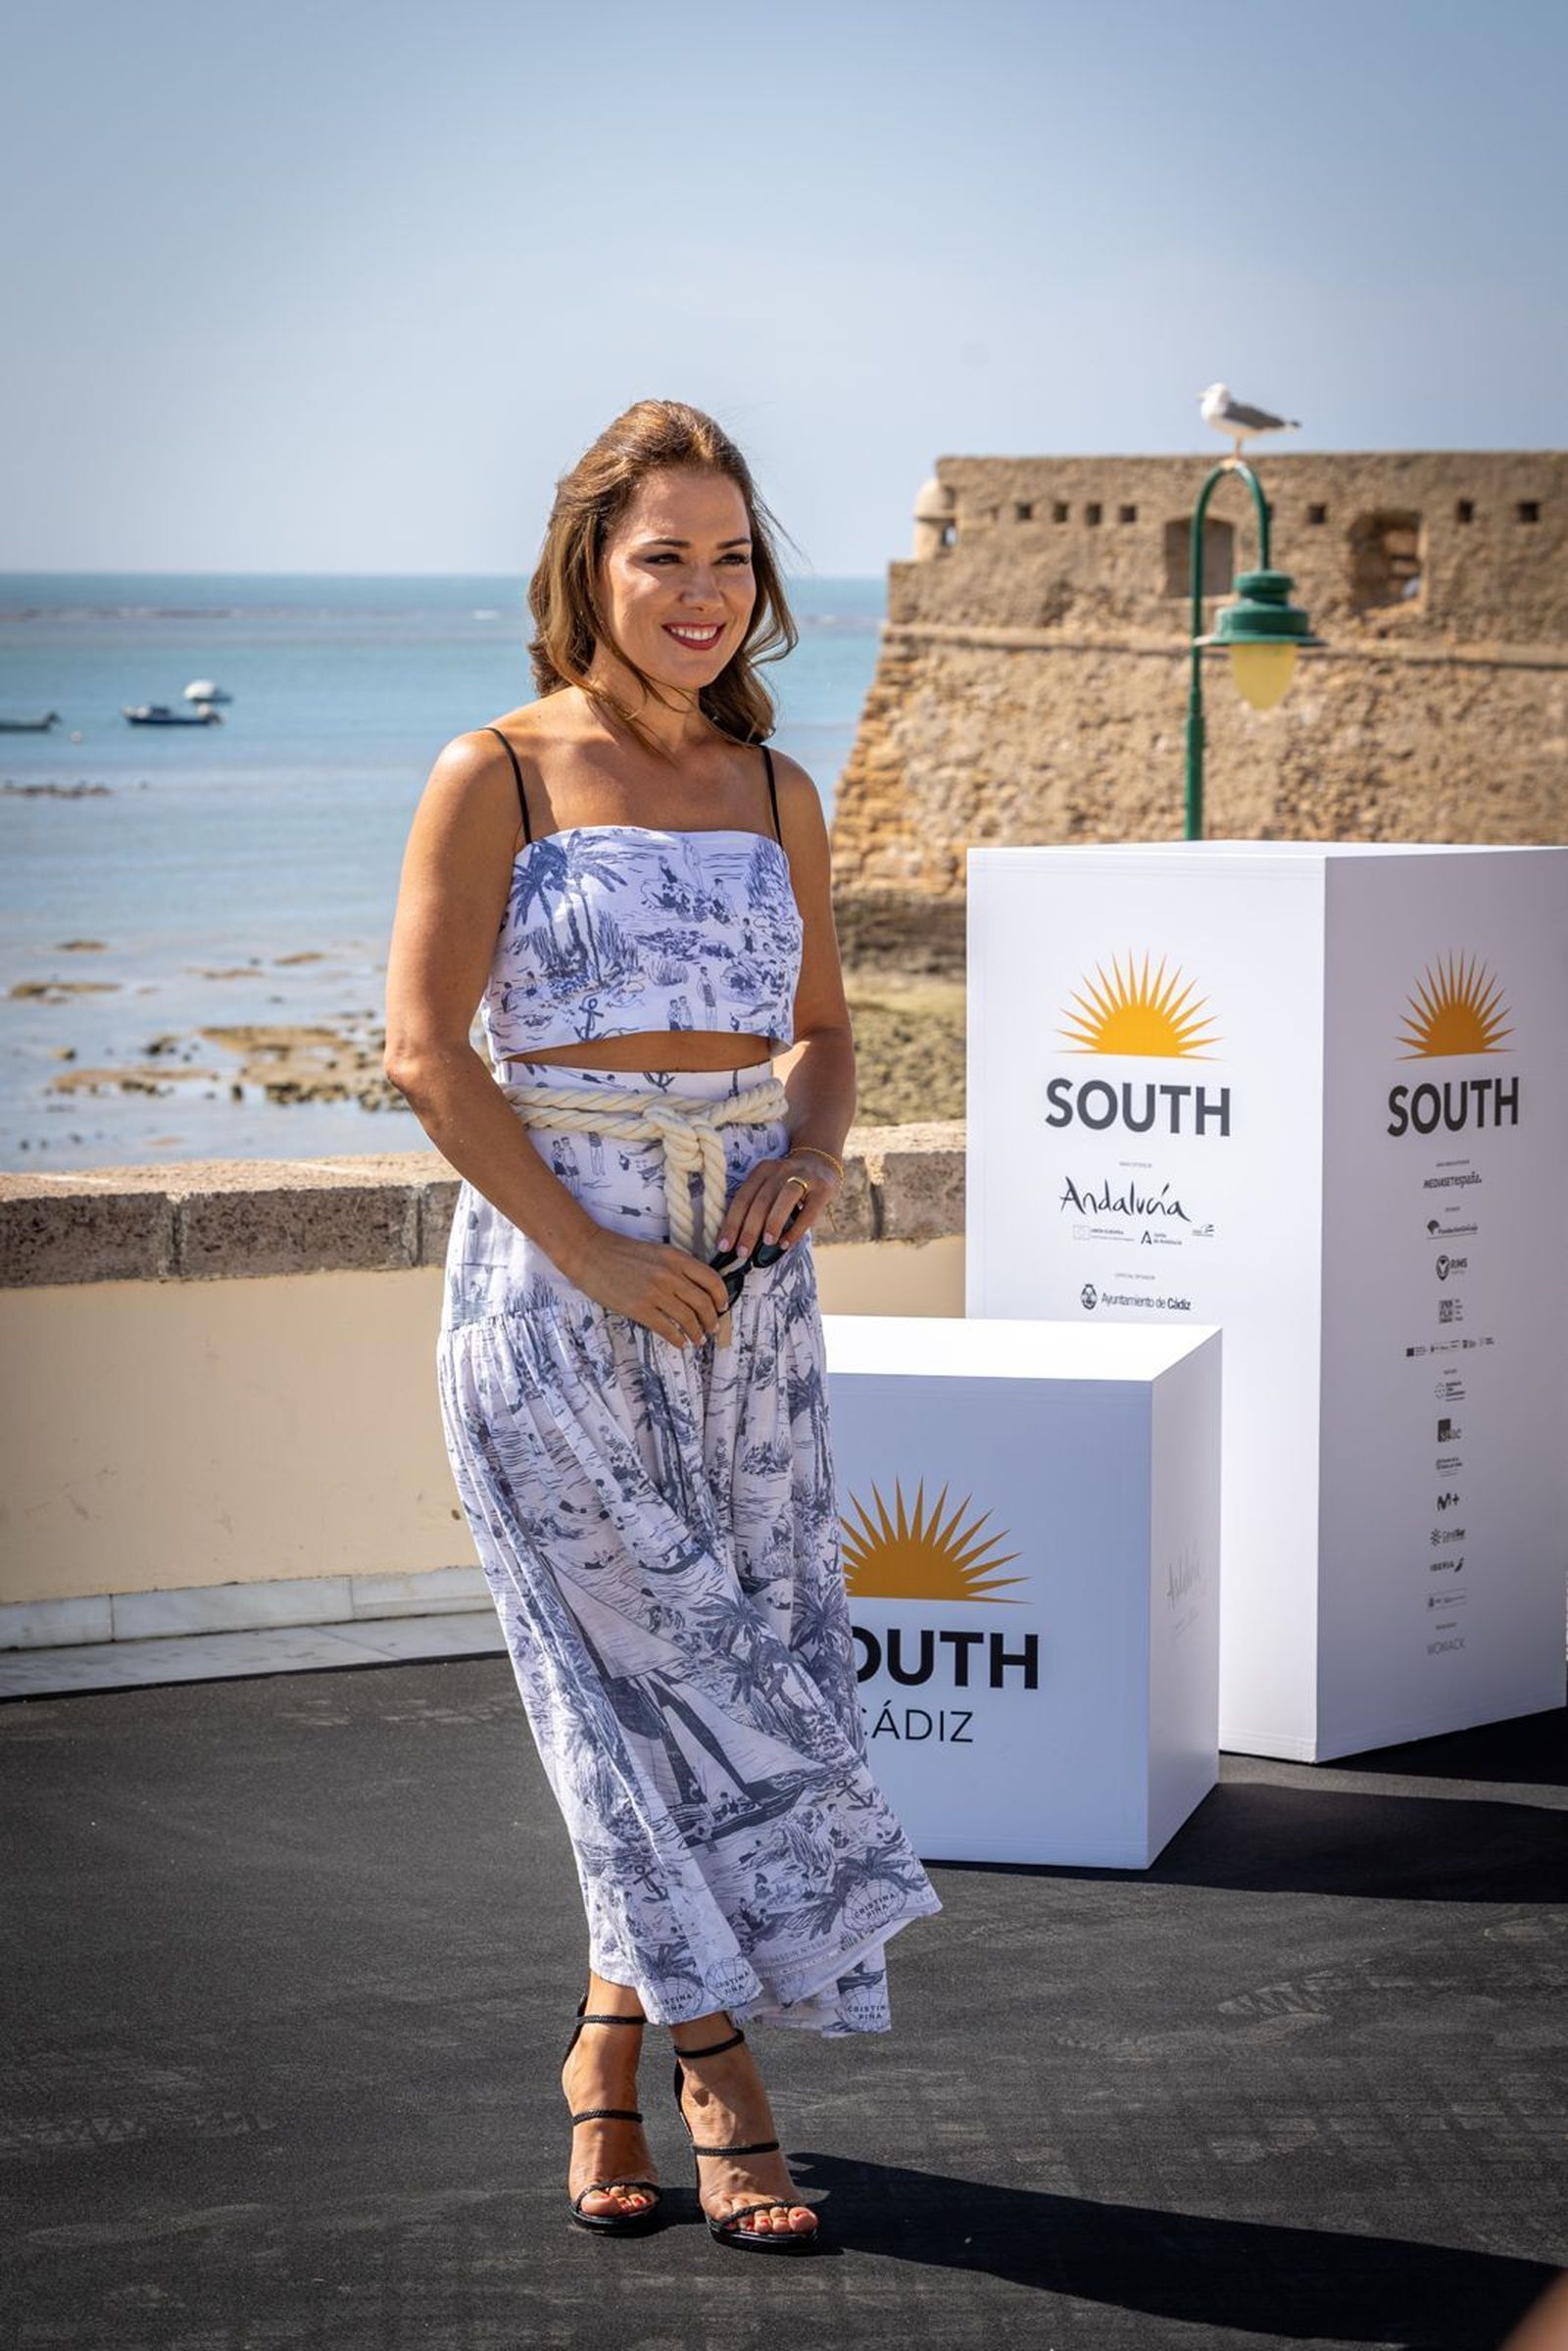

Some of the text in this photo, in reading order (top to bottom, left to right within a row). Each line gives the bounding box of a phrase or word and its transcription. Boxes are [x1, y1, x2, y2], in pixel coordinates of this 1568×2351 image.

[1046, 1077, 1230, 1137] SOUTH
[1387, 1076, 1519, 1138] SOUTH
[1059, 1175, 1192, 1223] Andalucía
[1101, 1292, 1192, 1311] Ayuntamiento de Cádiz
[852, 1625, 1039, 1690] UTH
[862, 1699, 973, 1743] ÁDIZ
[855, 1892, 896, 1919] CRISTINA
